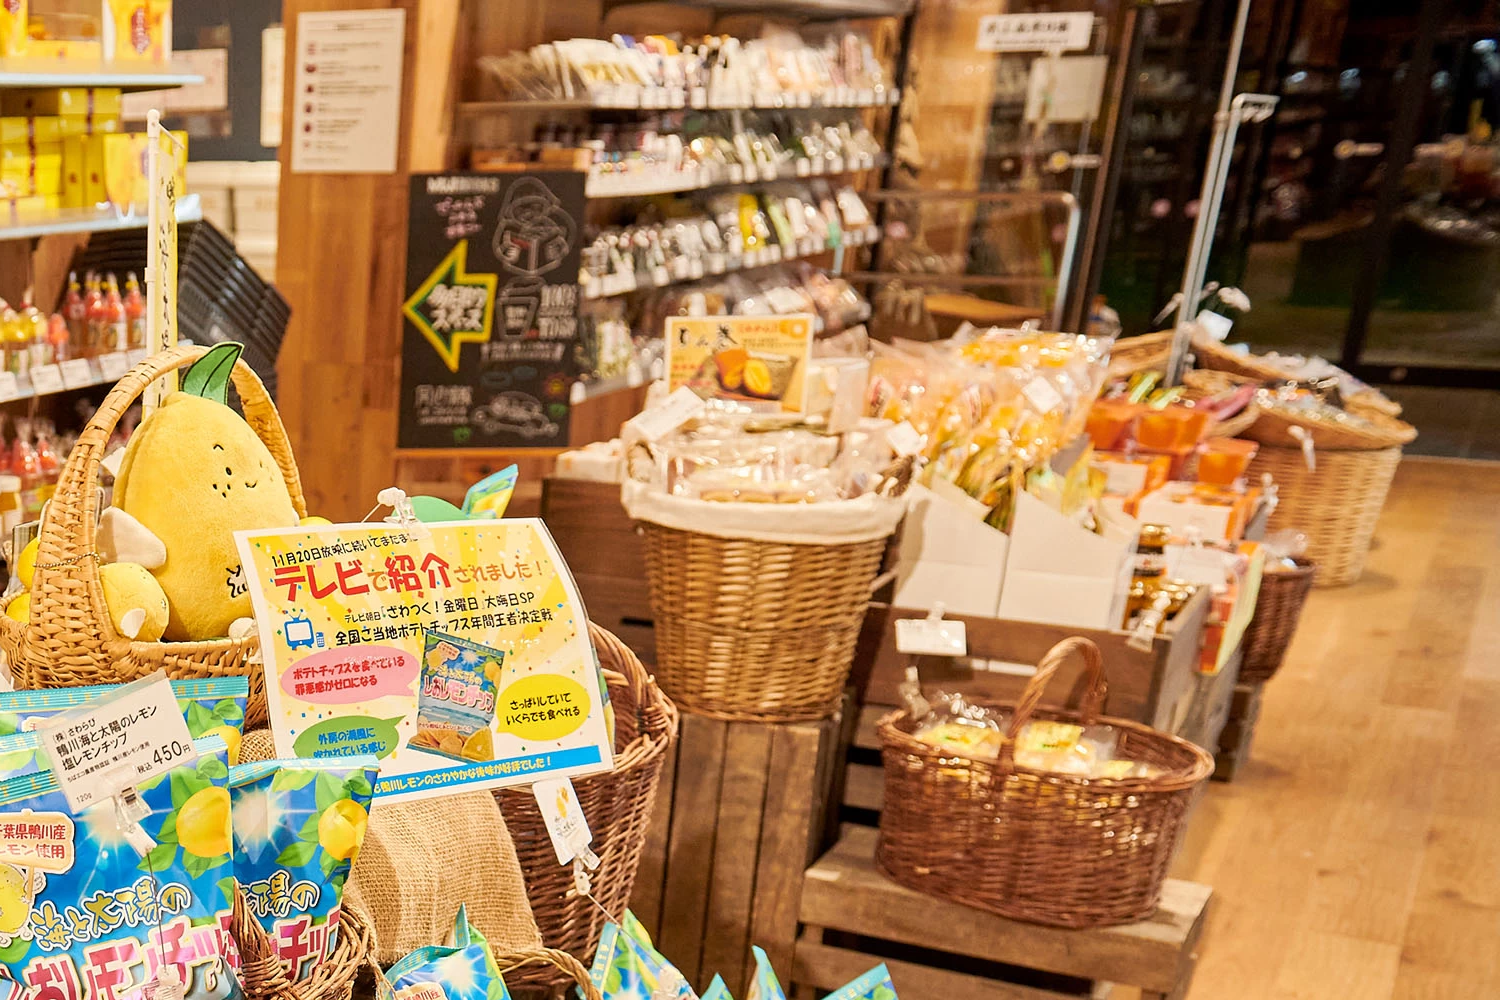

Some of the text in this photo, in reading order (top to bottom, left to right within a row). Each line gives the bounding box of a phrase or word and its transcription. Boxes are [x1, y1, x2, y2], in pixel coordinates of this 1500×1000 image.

[295, 675, 378, 696] 罪悪感がゼロになる
[506, 706, 581, 726] いくらでも食べれる
[56, 705, 158, 757] 鴨川海と太陽のレモン
[62, 733, 128, 771] 塩レモンチップ
[76, 793, 92, 804] 120g
[30, 876, 191, 950] 海と太陽の
